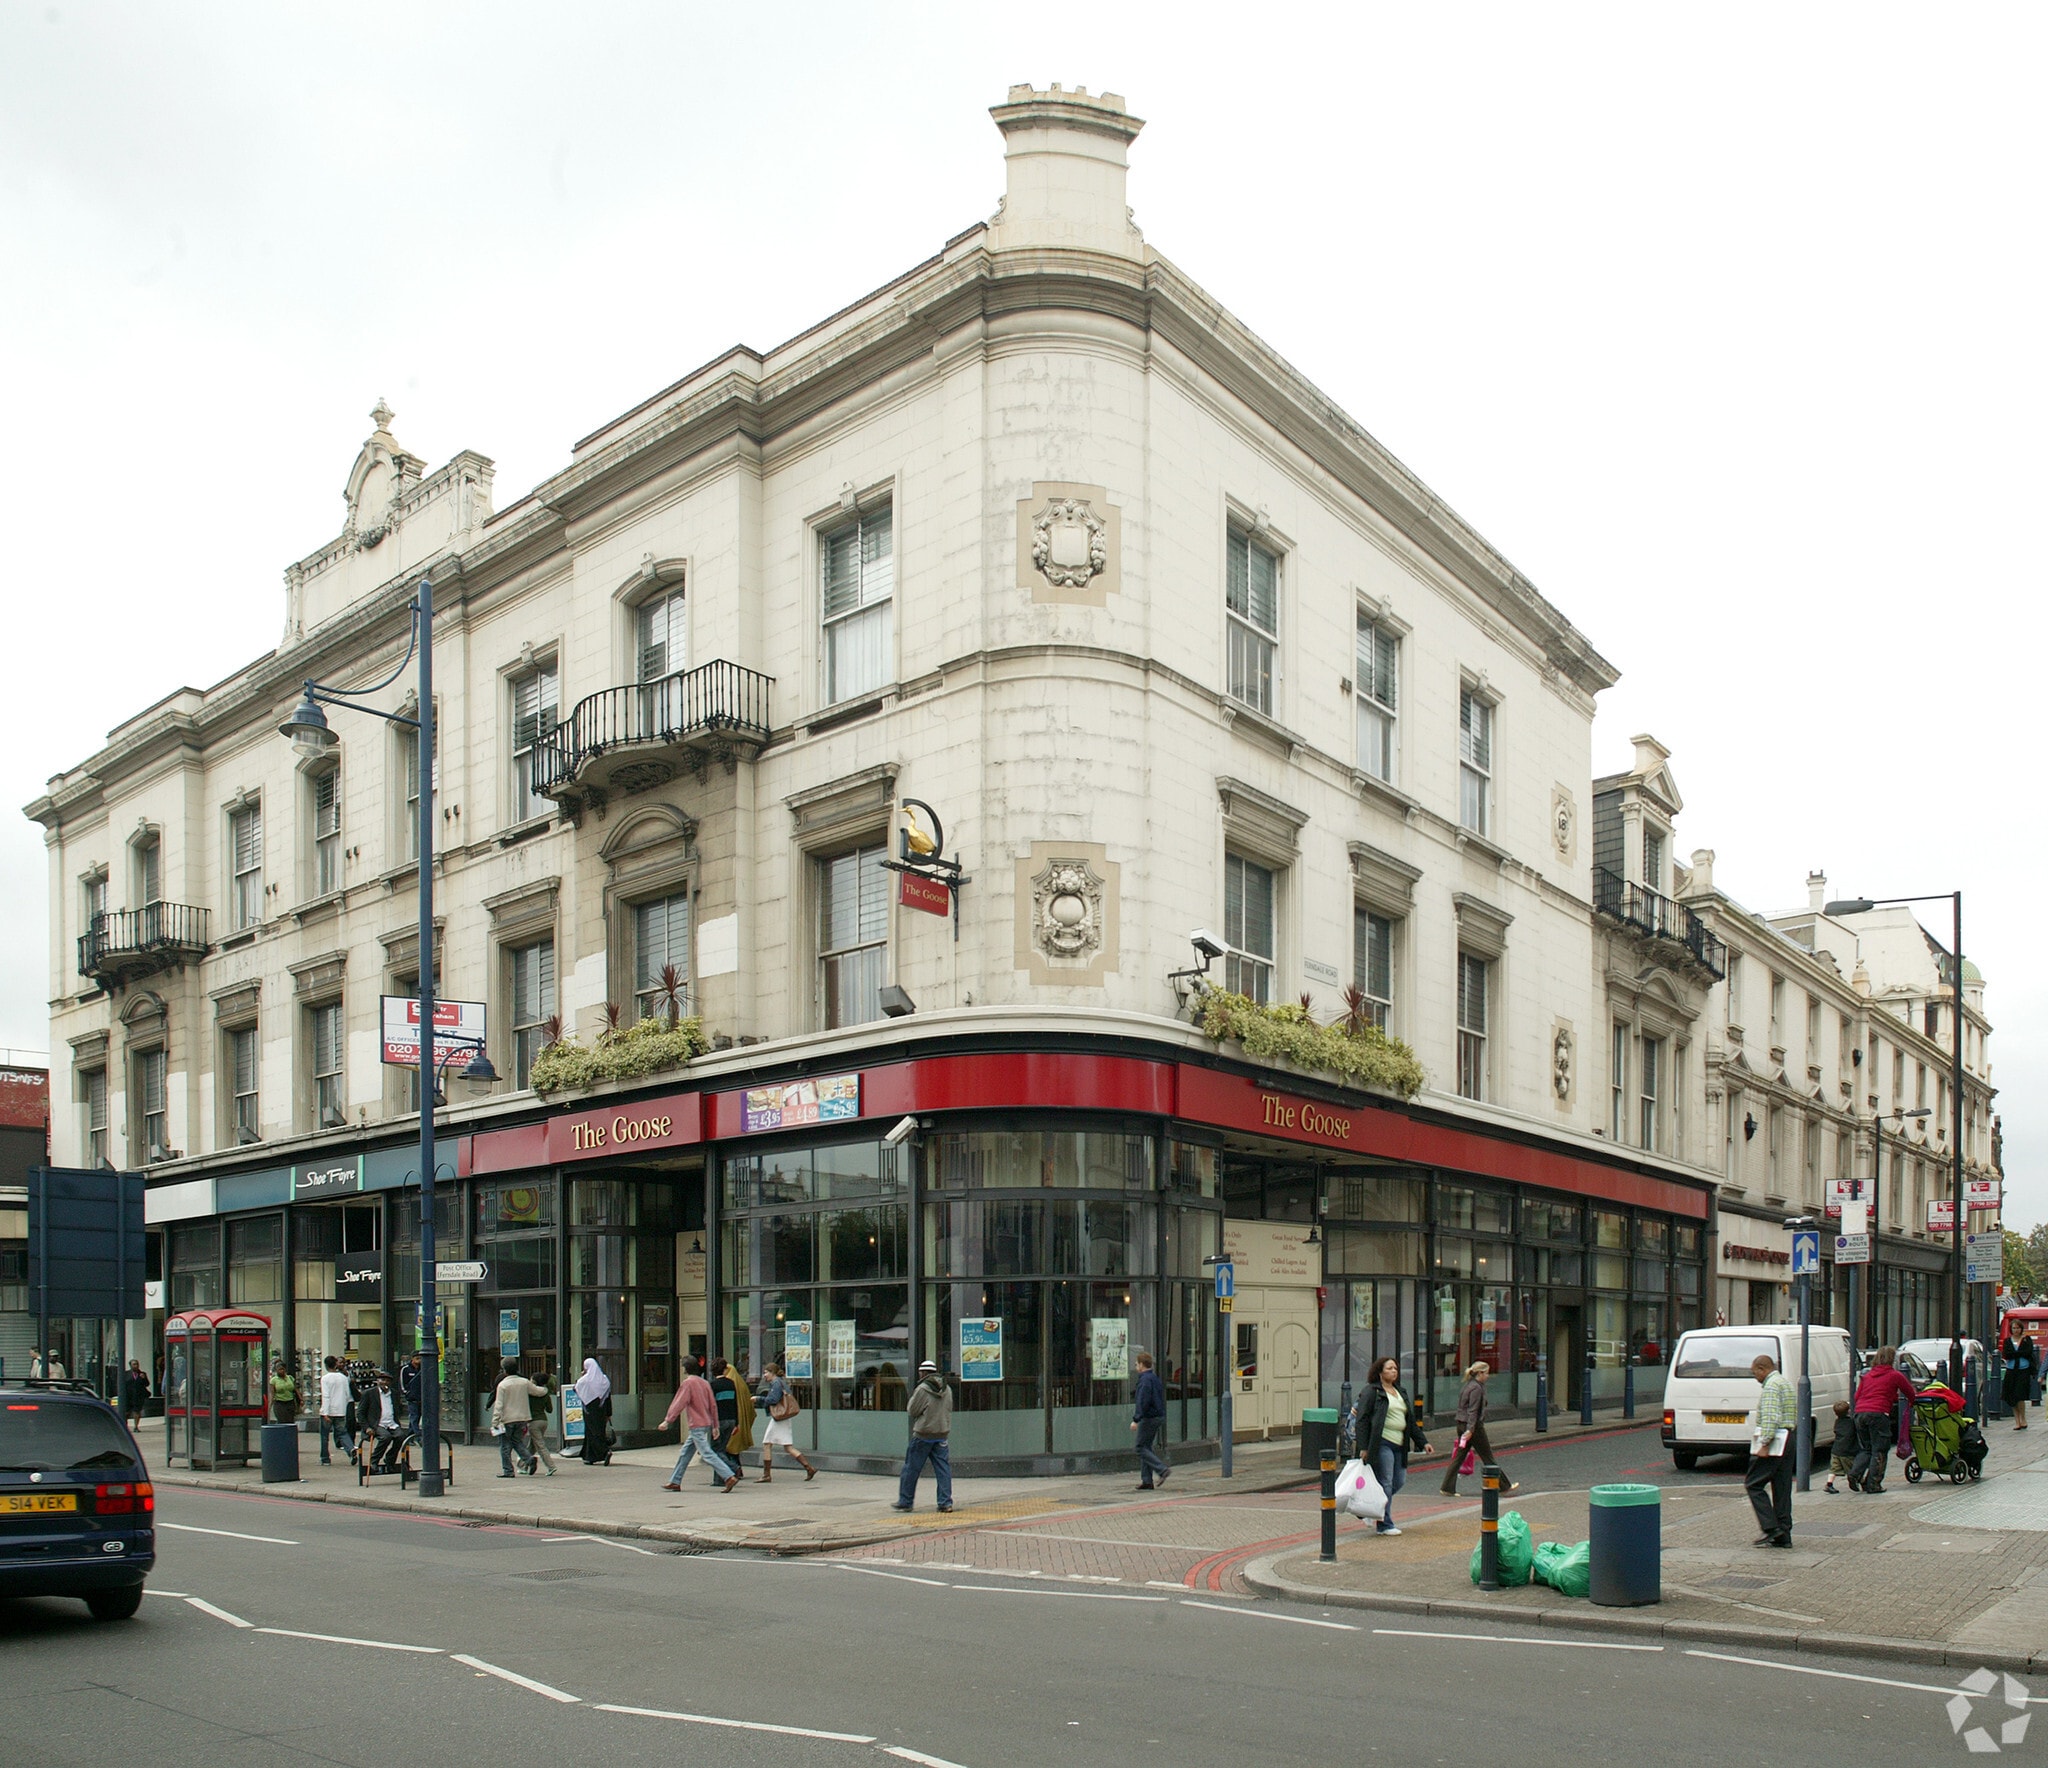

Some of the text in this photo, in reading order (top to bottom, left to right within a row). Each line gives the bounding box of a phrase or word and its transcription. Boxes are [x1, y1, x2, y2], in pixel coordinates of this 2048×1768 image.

[905, 883, 947, 904] The Goose
[388, 1044, 413, 1054] 020
[1262, 1094, 1351, 1139] The Goose
[571, 1115, 672, 1151] The Goose
[295, 1168, 356, 1187] Shoe Fayre
[336, 1270, 359, 1283] Shoe
[1221, 1297, 1232, 1311] H
[229, 1360, 246, 1369] BT
[38, 1496, 66, 1509] VEK
[105, 1542, 121, 1551] GB
